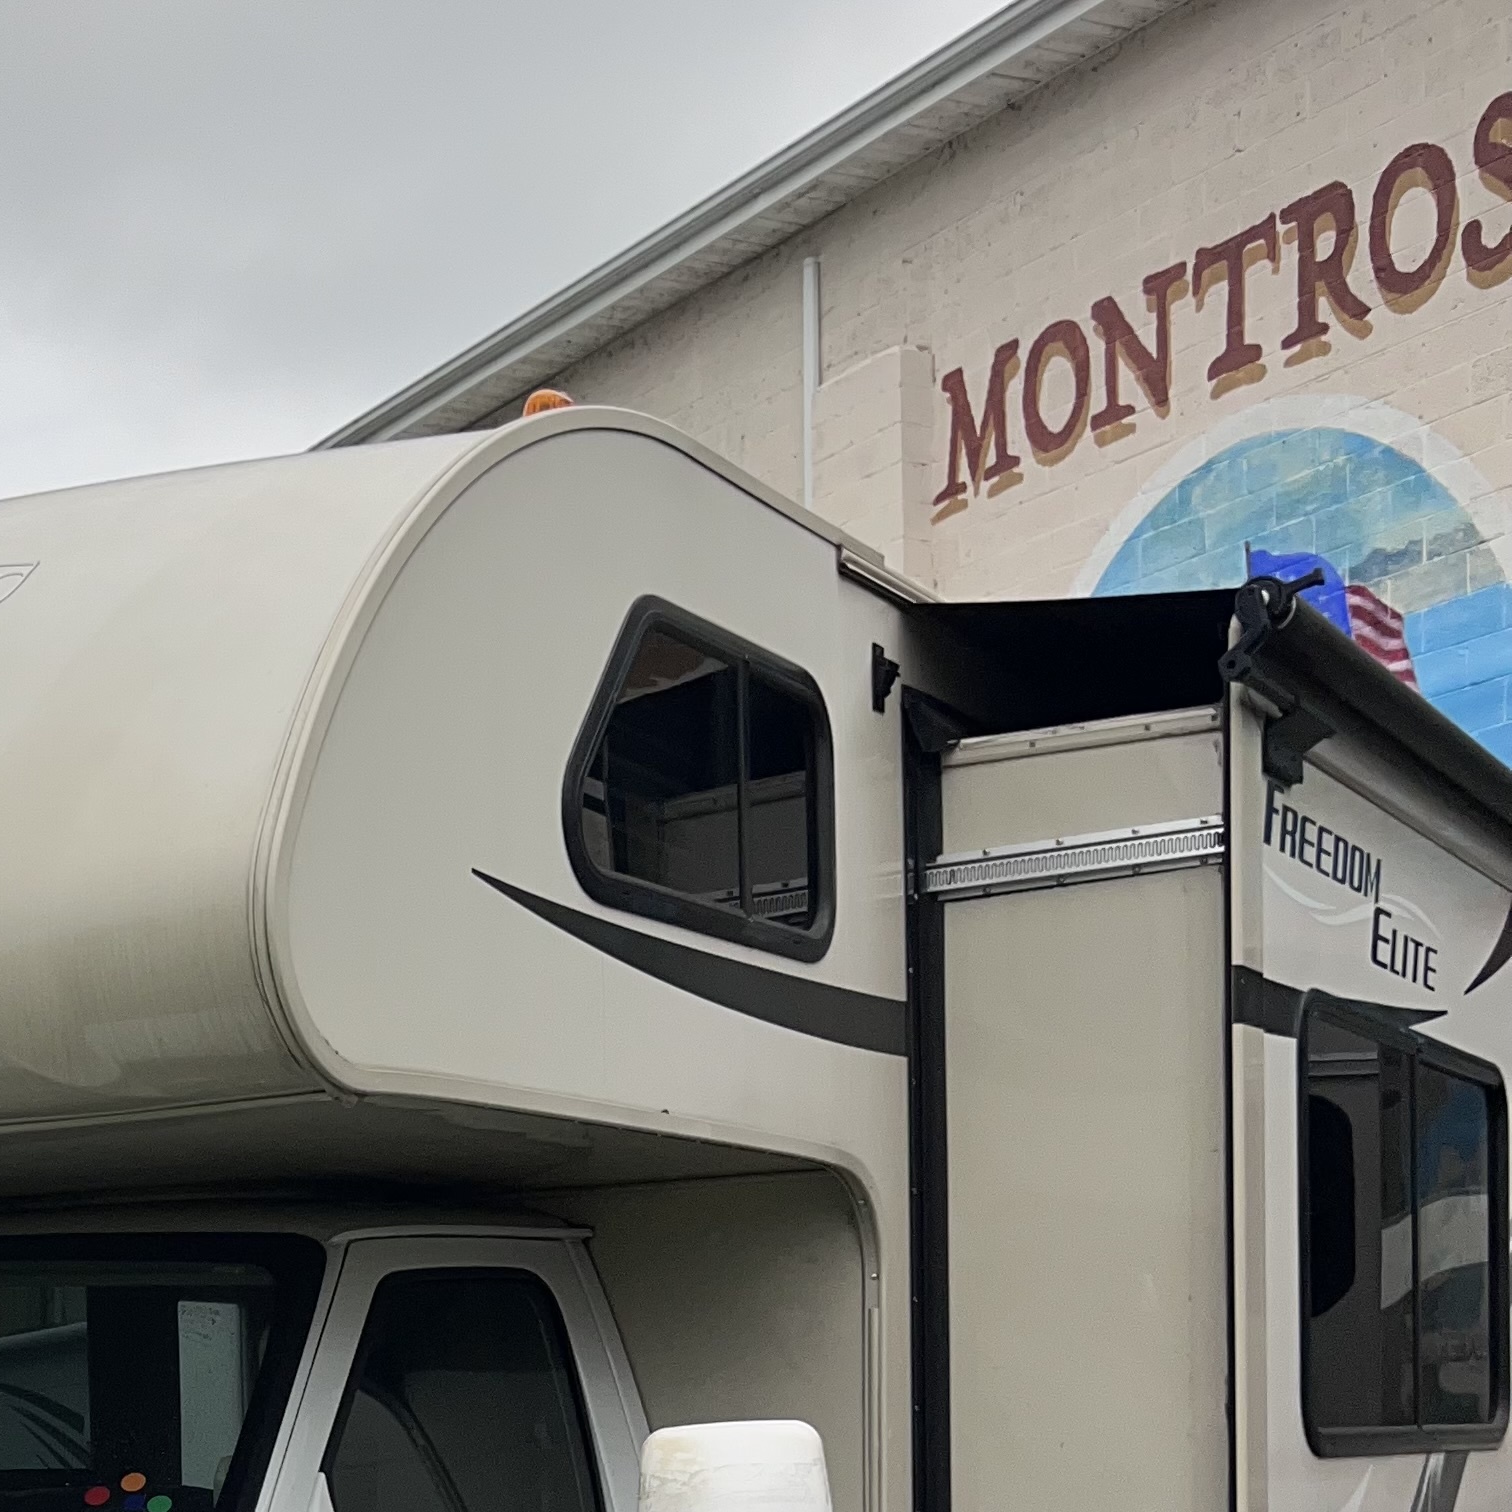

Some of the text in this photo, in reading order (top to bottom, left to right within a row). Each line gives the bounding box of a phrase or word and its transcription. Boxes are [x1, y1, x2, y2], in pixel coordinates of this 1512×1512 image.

[931, 91, 1512, 525] MONTROS
[1263, 779, 1382, 904] FREEDOM
[1370, 905, 1438, 992] ELITE
